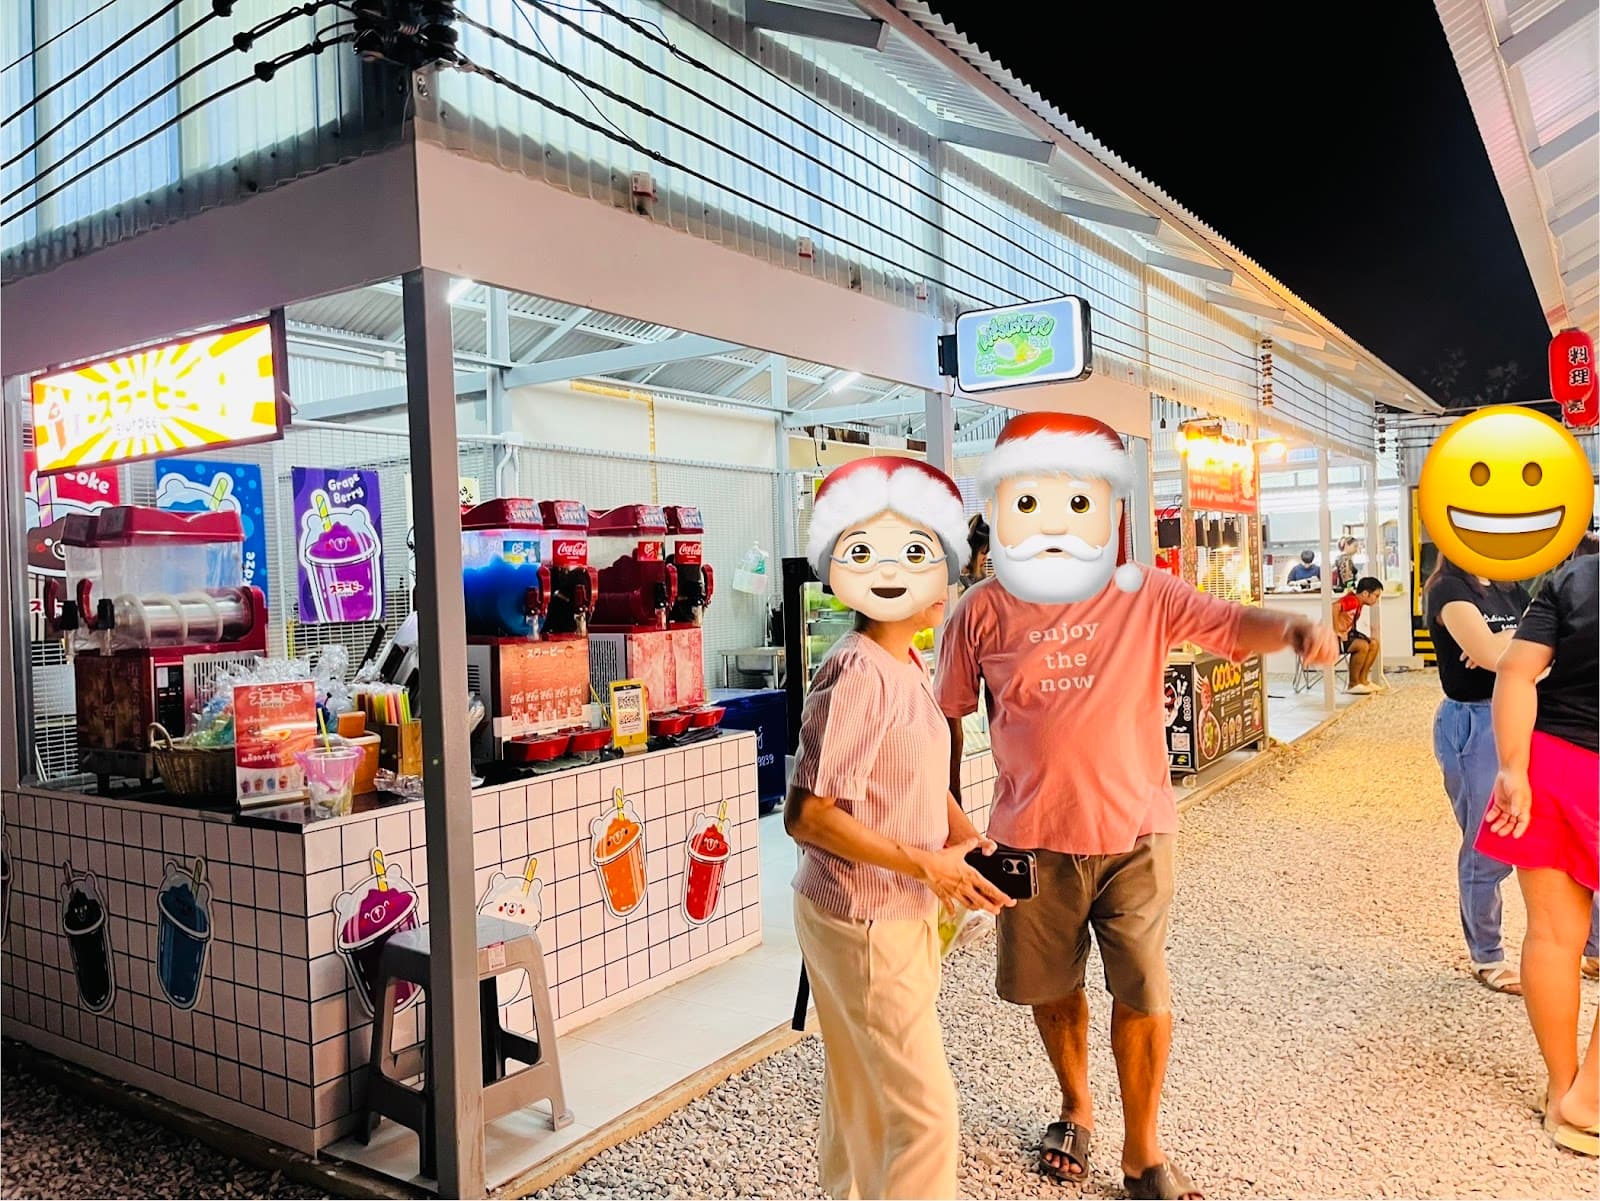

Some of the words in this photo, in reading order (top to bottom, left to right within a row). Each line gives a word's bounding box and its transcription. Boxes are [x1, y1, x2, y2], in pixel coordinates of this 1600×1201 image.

[1568, 346, 1590, 387] 料理
[328, 473, 360, 490] Grape
[333, 486, 365, 504] Berry
[1028, 622, 1099, 645] enjoy
[1044, 651, 1088, 670] the
[1040, 675, 1095, 692] now
